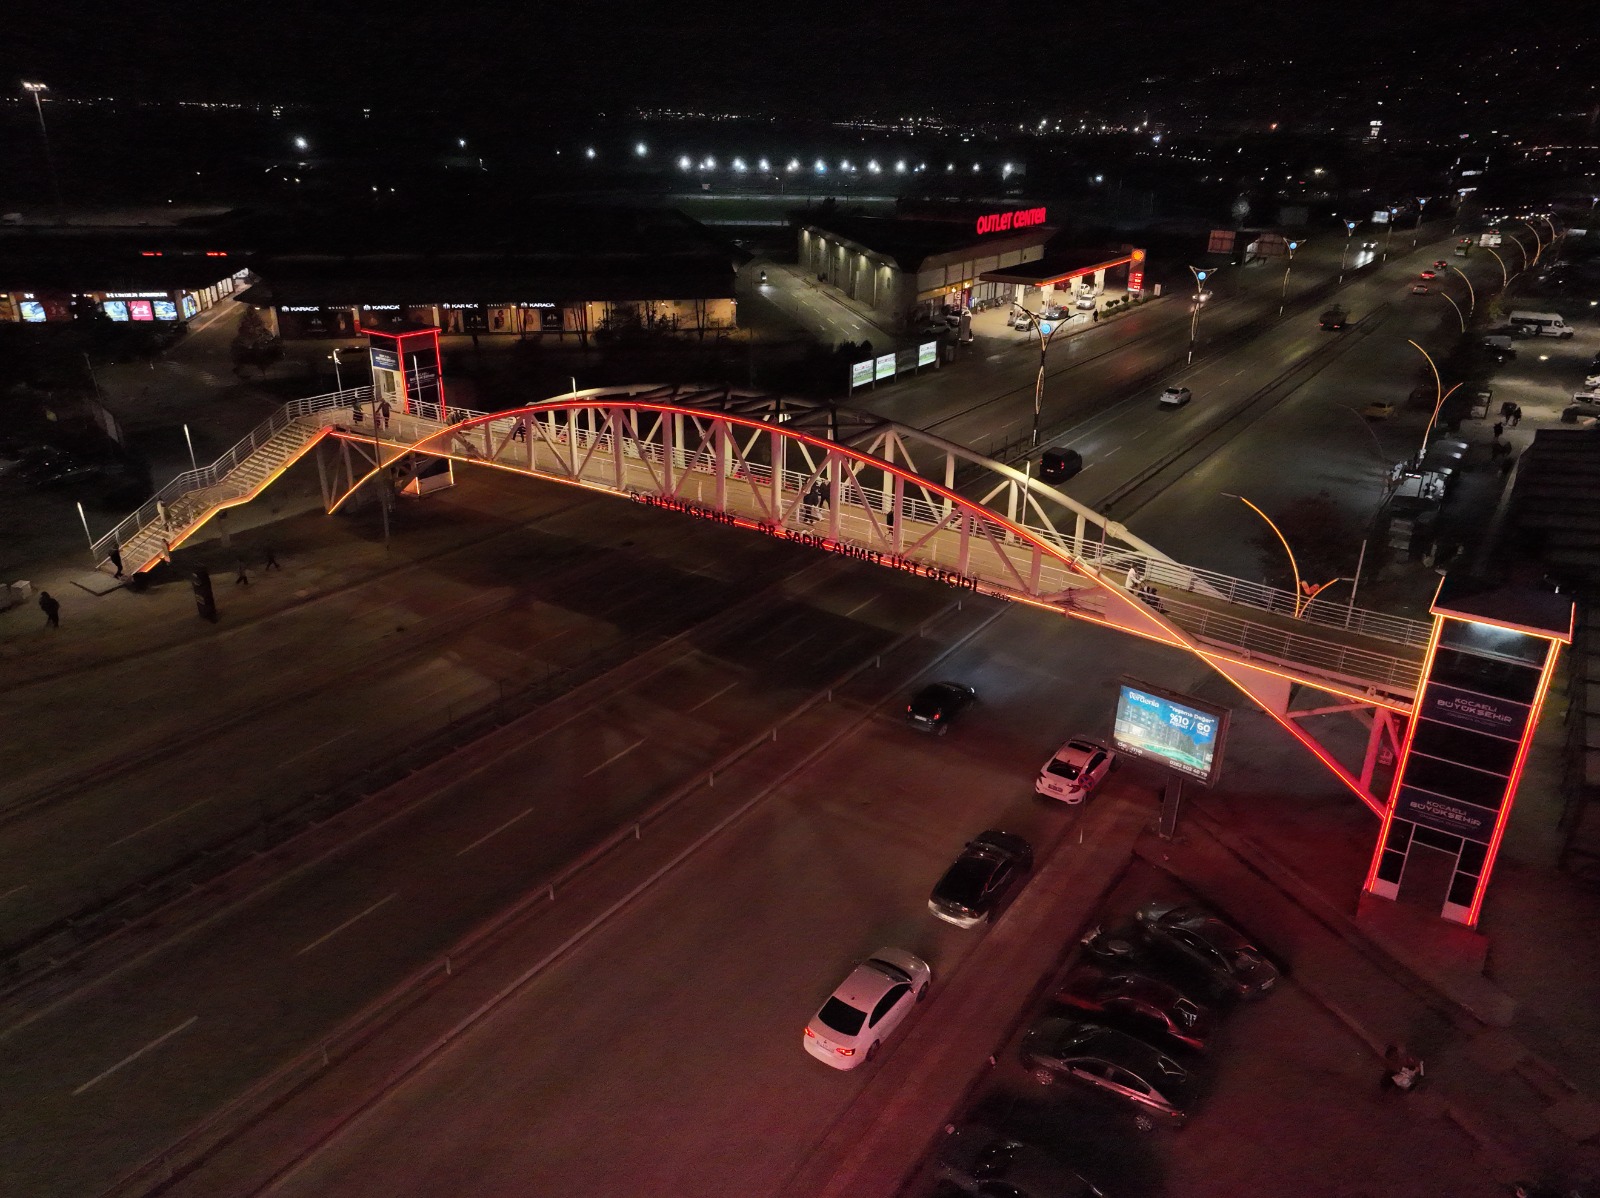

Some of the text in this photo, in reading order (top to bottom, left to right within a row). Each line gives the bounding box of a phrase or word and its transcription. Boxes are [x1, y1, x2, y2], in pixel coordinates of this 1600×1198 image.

[977, 207, 1047, 235] OUTLET CENTER
[785, 529, 827, 549] SADIK
[833, 543, 884, 564] AHMET
[892, 554, 919, 575] ÜST
[926, 566, 978, 592] GEÇİDİ
[1169, 713, 1190, 726] %10
[1197, 722, 1211, 733] 60
